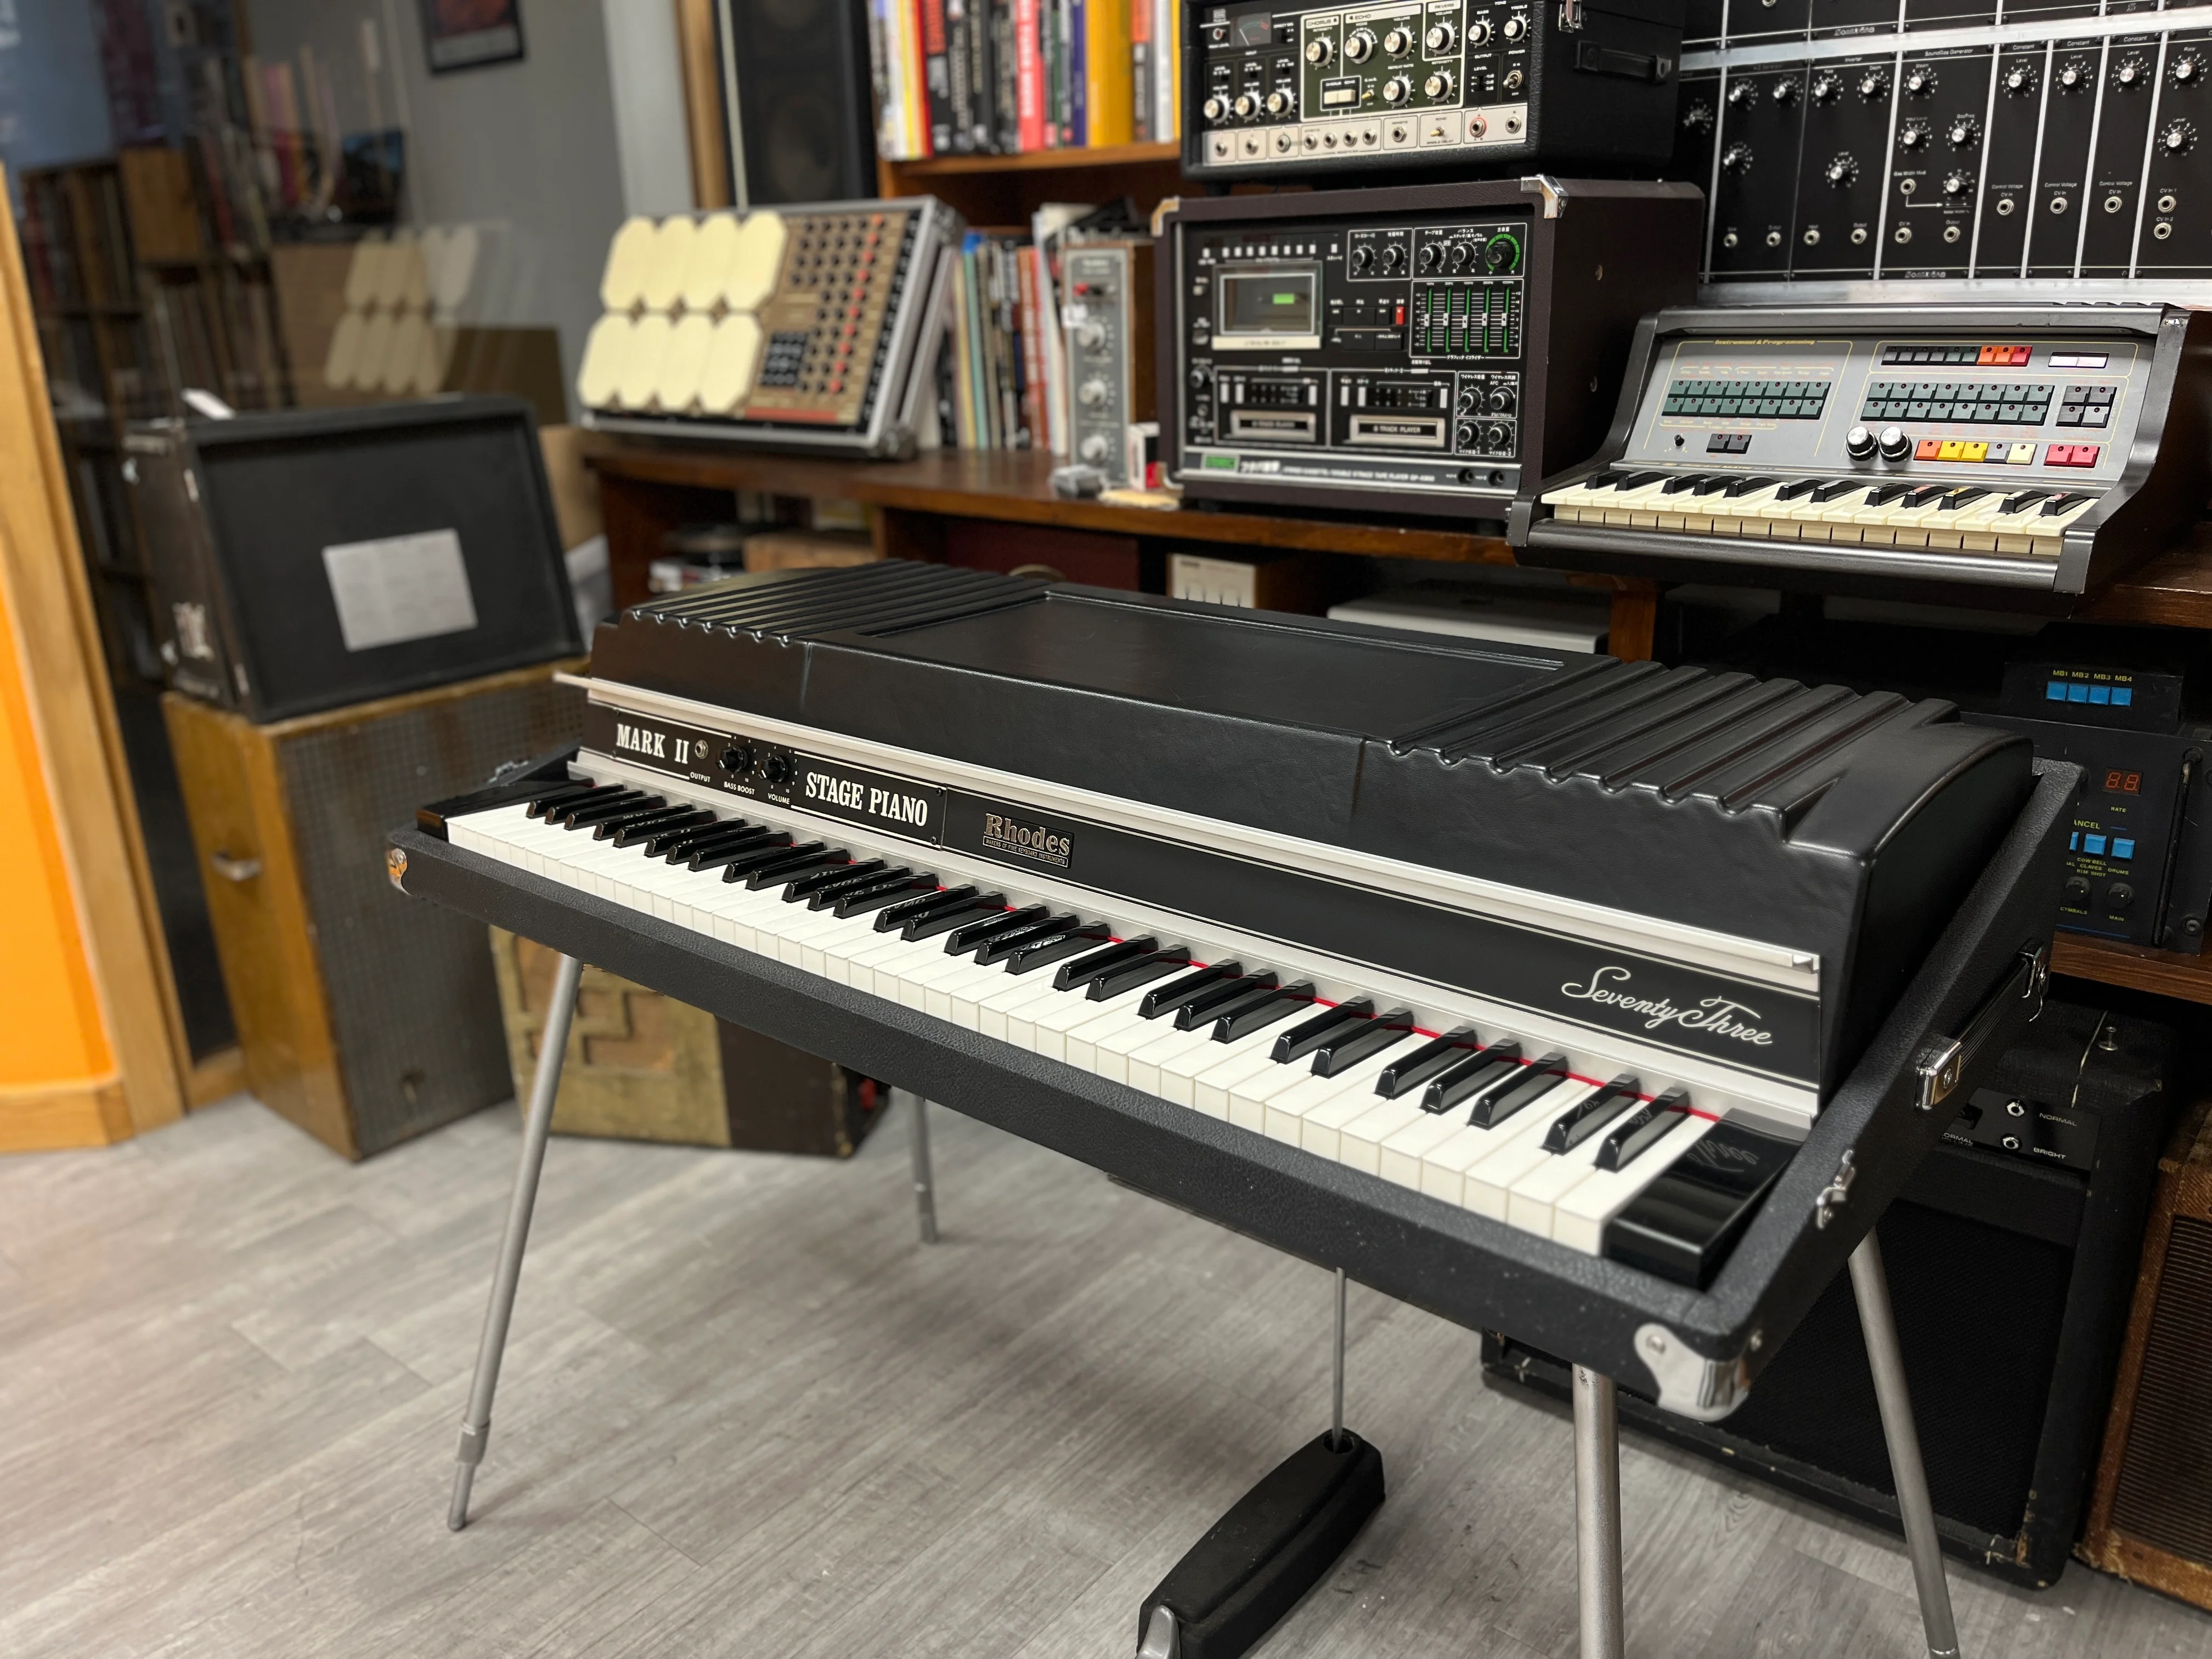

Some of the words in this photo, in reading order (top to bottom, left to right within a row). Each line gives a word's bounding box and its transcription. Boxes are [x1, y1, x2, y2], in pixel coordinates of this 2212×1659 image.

[616, 724, 665, 758] MARK
[675, 739, 690, 764] II
[690, 772, 710, 782] OUTPUT
[724, 781, 737, 791] BASS
[737, 784, 755, 795] BOOST
[768, 793, 790, 804] VOLUME
[805, 771, 864, 810] STAGE
[868, 788, 928, 827] PIANO
[984, 813, 1070, 856] Rhodes
[986, 839, 1001, 848] MAKERS
[1018, 847, 1038, 857] KEYBOARD
[1039, 852, 1065, 865] INSTRUMENTS
[2060, 907, 2087, 915] CYMBALS
[2039, 1113, 2077, 1127] NORMAL
[1942, 1132, 1973, 1144] ORMAL
[2033, 1147, 2067, 1159] BRIGHT
